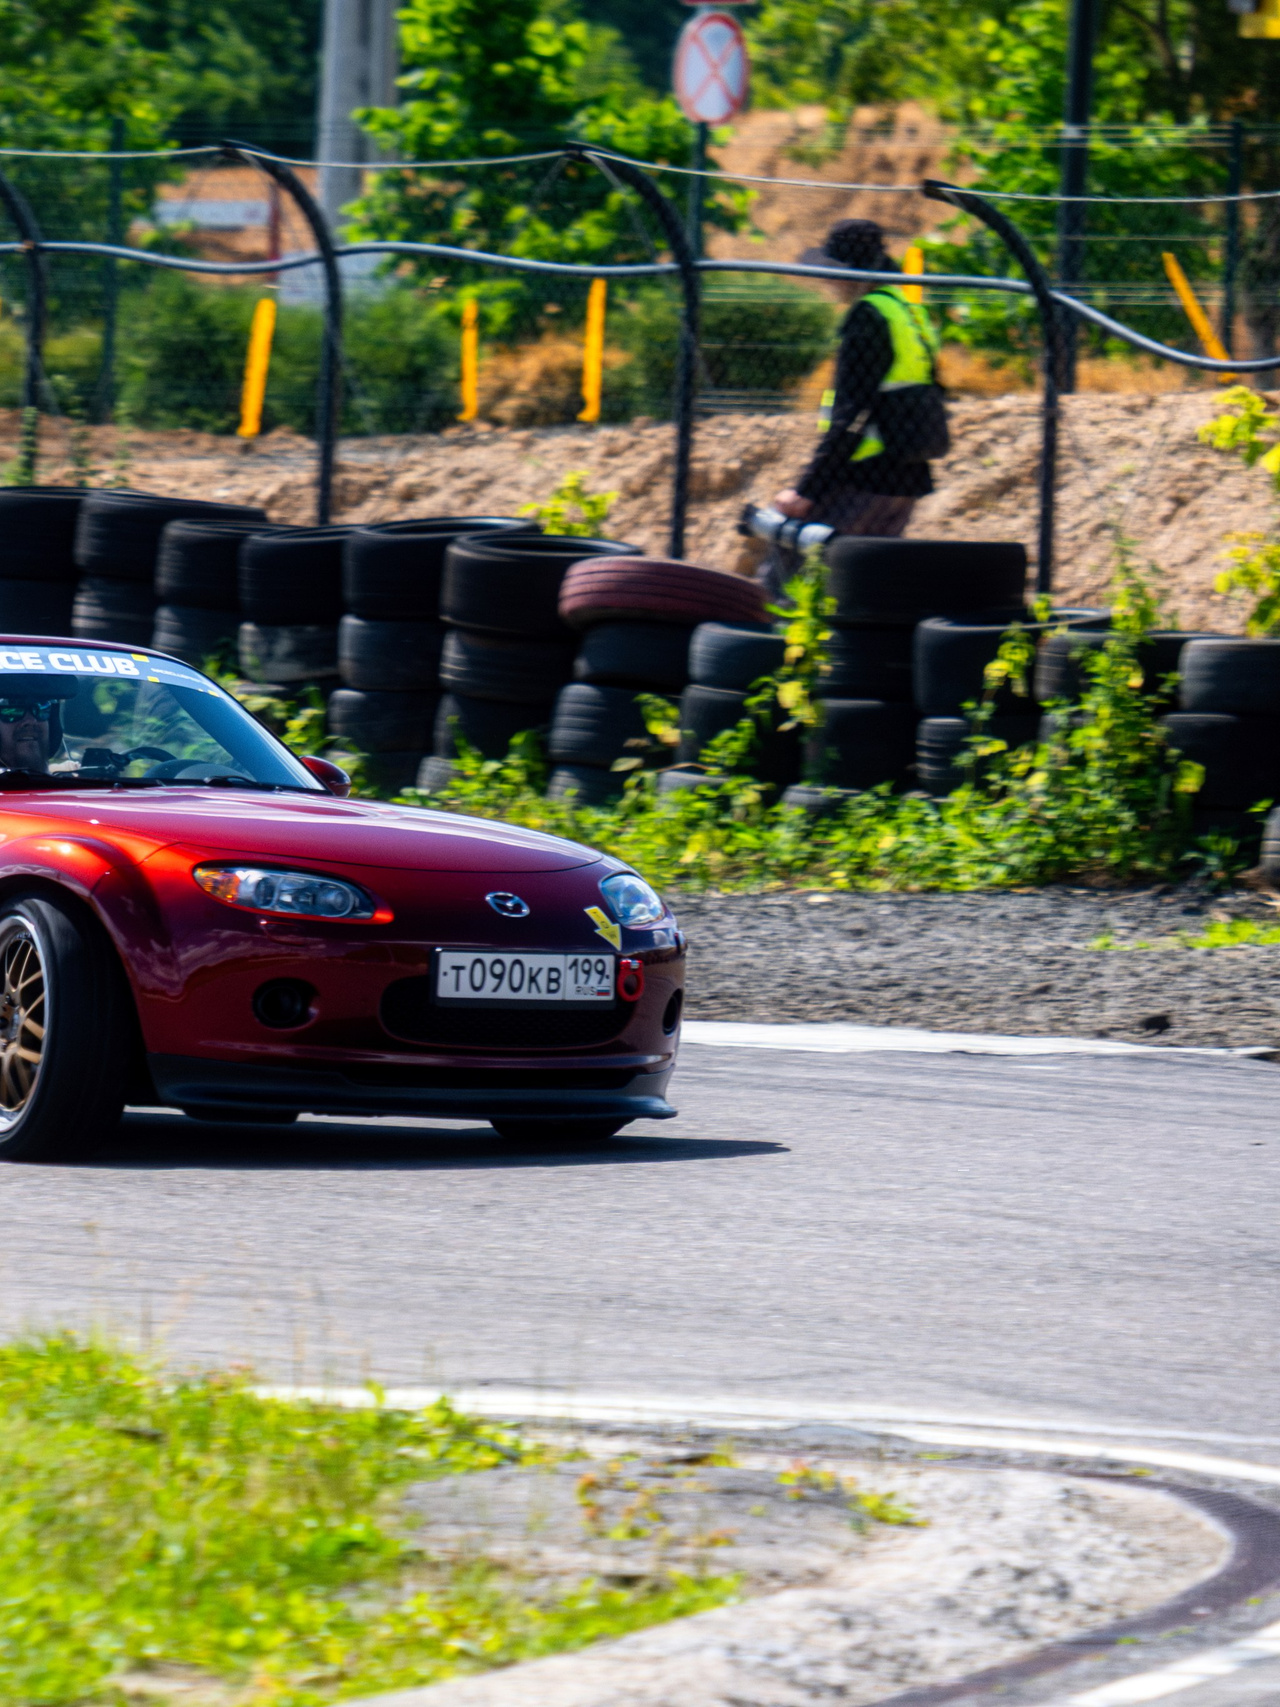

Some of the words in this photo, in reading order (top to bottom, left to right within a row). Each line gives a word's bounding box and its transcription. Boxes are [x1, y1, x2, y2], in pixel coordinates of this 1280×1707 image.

[48, 653, 140, 676] CLUB
[568, 957, 607, 985] 199
[575, 985, 597, 996] RUS
